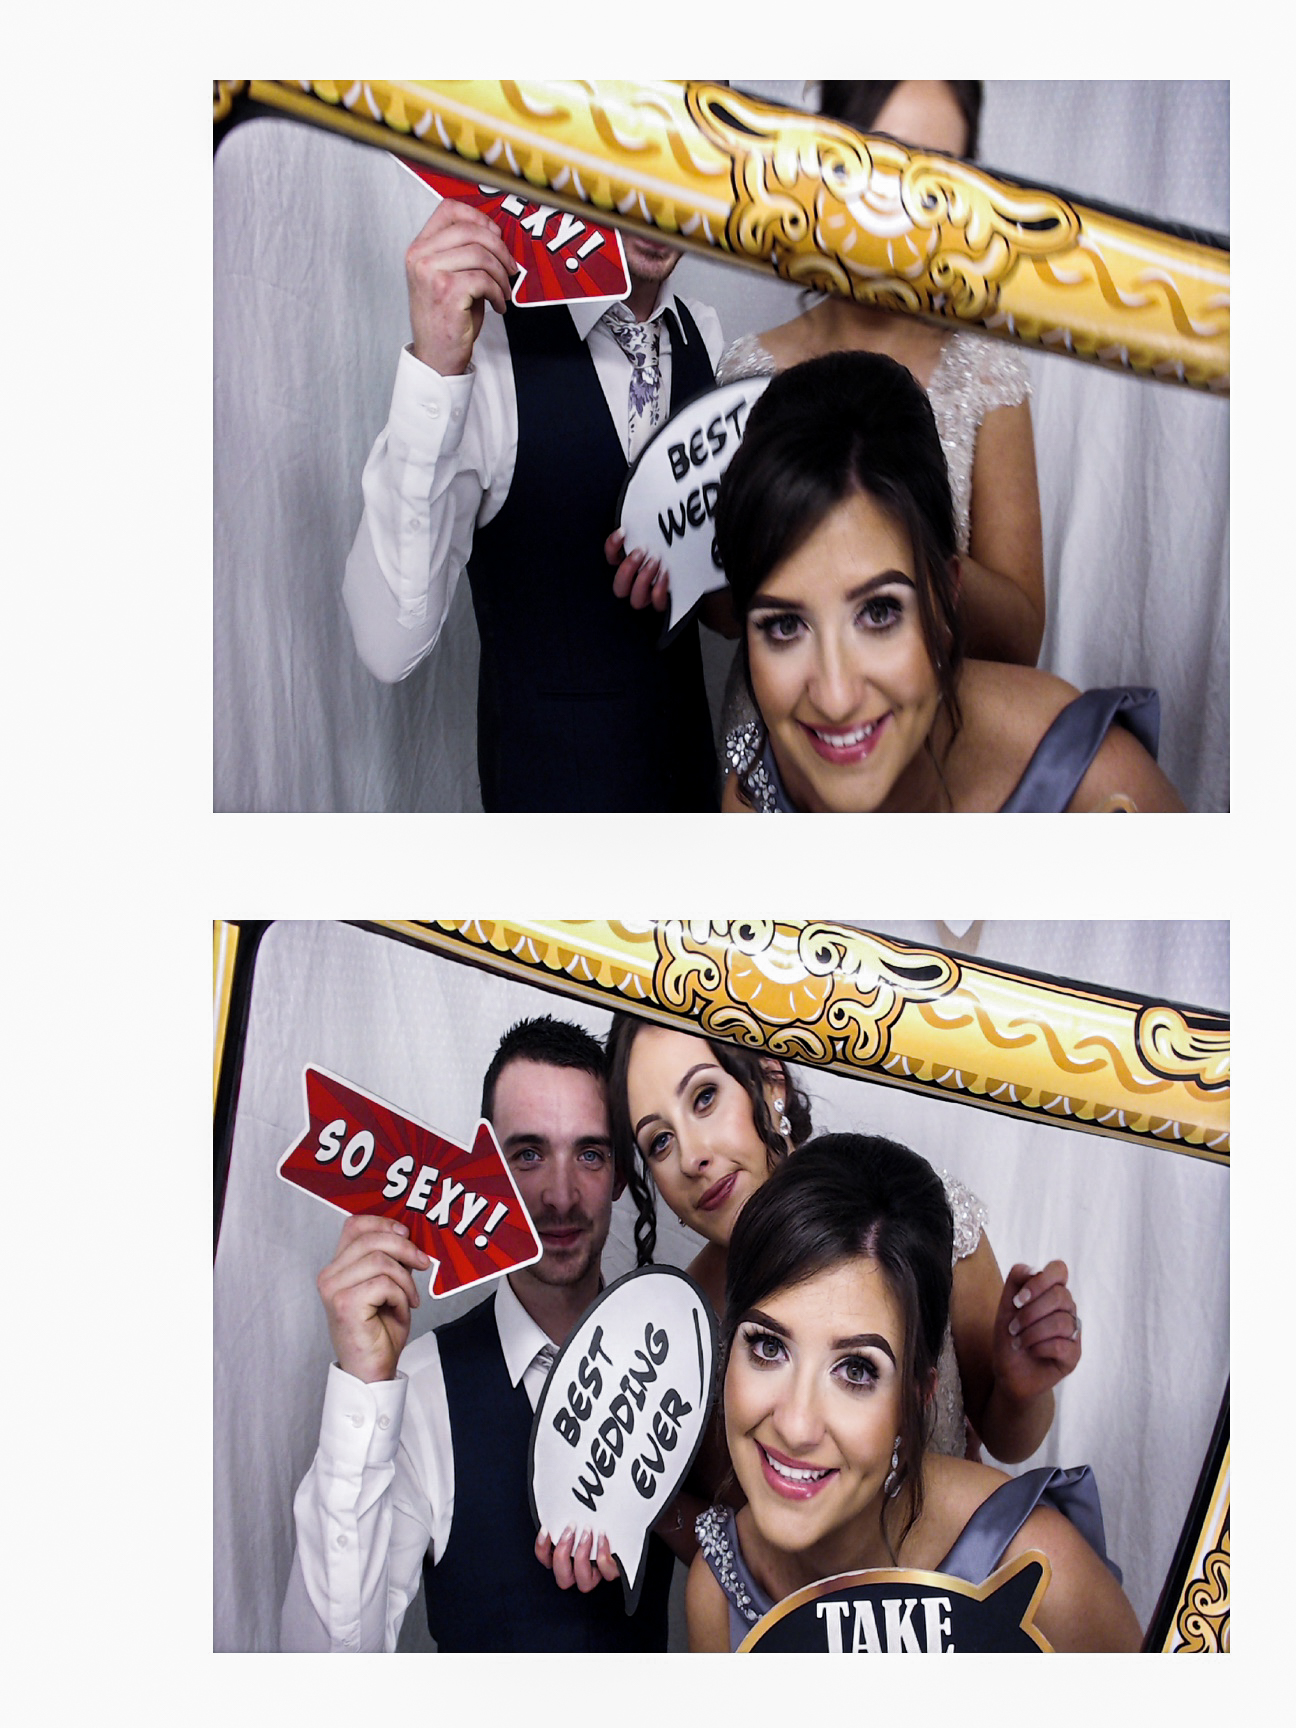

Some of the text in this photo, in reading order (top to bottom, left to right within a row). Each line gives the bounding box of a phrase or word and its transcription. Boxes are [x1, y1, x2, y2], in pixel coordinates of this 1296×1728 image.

[478, 184, 605, 273] EXY!
[668, 398, 747, 482] BEST
[658, 481, 723, 547] WED
[315, 1118, 510, 1251] SO SEXY!
[552, 1325, 615, 1448] BEST
[572, 1322, 670, 1512] WEDDING
[630, 1388, 693, 1500] EVER
[816, 1597, 956, 1653] TAKE
